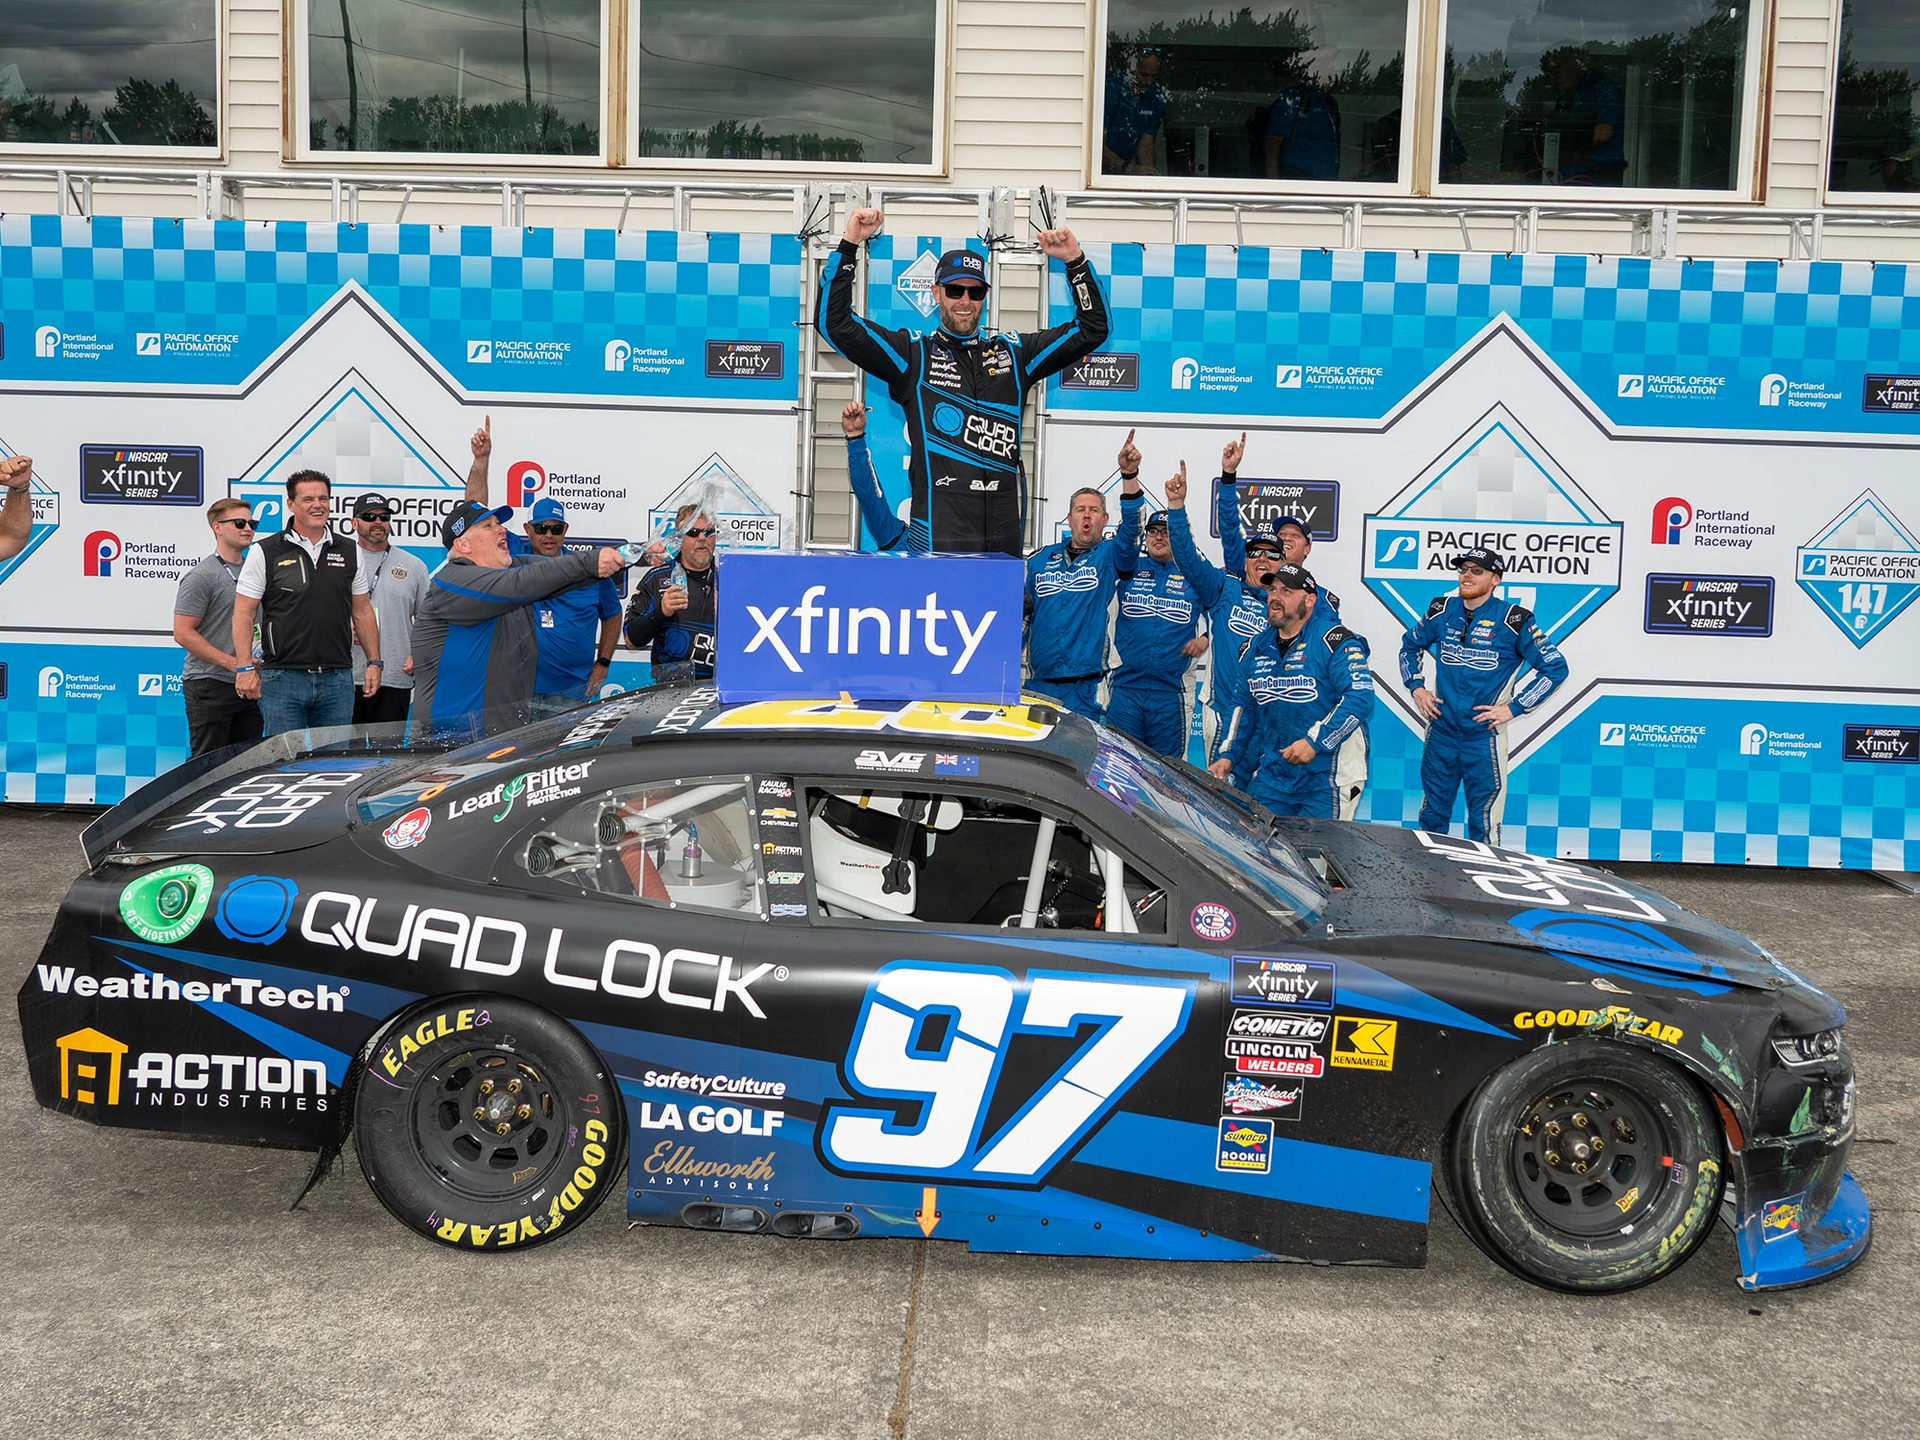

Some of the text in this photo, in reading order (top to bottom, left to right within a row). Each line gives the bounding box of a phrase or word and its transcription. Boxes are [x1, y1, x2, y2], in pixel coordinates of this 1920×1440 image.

[62, 333, 97, 342] Portland
[164, 334, 238, 343] PACIFIC OFFICE
[62, 342, 114, 351] International
[164, 342, 232, 352] AUTOMATION
[495, 342, 571, 352] PACIFIC OFFICE
[633, 347, 668, 356] Portland
[62, 350, 101, 360] Raceway
[496, 350, 563, 360] AUTOMATION
[1090, 356, 1117, 364] NASCAR
[633, 356, 685, 366] International
[719, 352, 770, 372] xfinity
[632, 364, 671, 375] Raceway
[1073, 363, 1126, 382] xfinity
[1200, 365, 1236, 374] Portland
[1306, 366, 1382, 376] PACIFIC OFFICE
[1088, 379, 1110, 387] SERIES
[1200, 374, 1253, 384] International
[1306, 374, 1374, 385] AUTOMATION
[1647, 376, 1726, 386] PACIFIC OFFICE
[1200, 382, 1239, 392] Raceway
[1647, 384, 1718, 395] AUTOMATION
[1788, 381, 1825, 390] Portland
[1788, 390, 1842, 400] International
[1876, 386, 1920, 405] xfinit
[1788, 399, 1827, 409] Raceway
[966, 414, 1016, 443] QUAD
[128, 452, 168, 463] NASCAR
[101, 464, 182, 492] xfinity
[549, 473, 600, 484] Portland
[125, 489, 158, 498] SERIES
[549, 486, 626, 498] International
[1262, 486, 1304, 497] NASCAR
[1696, 510, 1749, 522] Portland
[731, 520, 774, 531] OFFICE
[1695, 522, 1775, 536] International
[124, 542, 176, 554] Portland
[1427, 531, 1611, 554] PACIFIC OFFICE
[1694, 536, 1752, 550] Raceway
[1830, 555, 1920, 568] PACIFIC OFFIC
[124, 568, 180, 581] Raceway
[1830, 566, 1915, 579] AUTOMATION
[1696, 582, 1738, 594] NASCAR
[1838, 583, 1888, 614] 147
[1666, 593, 1752, 624] xfinity
[1690, 618, 1726, 629] SERIES
[743, 586, 998, 674] xfinity
[65, 674, 99, 682] Portland
[65, 682, 116, 691] International
[65, 690, 102, 700] Raceway
[1629, 724, 1706, 735] PACIFIC OFFICE
[1874, 729, 1900, 737] NASCAR
[1629, 734, 1698, 744] AUTOMATION
[1768, 731, 1805, 740] Portland
[1768, 740, 1822, 750] International
[1856, 737, 1910, 754] xfinity
[1768, 748, 1807, 758] Raceway
[1870, 752, 1893, 760] SERIES
[448, 759, 597, 820] Leaf Filter
[760, 780, 788, 788] KAULIG
[526, 785, 561, 800] GUTTER
[526, 786, 580, 808] PROTECTION
[760, 820, 799, 828] CHEVROLET
[840, 860, 880, 870] WeatherTech
[1196, 905, 1230, 920] NASCAR
[126, 910, 200, 942] GET BIOETHANOL
[1196, 924, 1231, 938] SALUTES
[300, 891, 528, 977] QUAD
[1270, 962, 1307, 974] NASCAR
[1247, 971, 1318, 1000] xfinity
[1267, 992, 1298, 1002] SERIES
[1232, 1016, 1324, 1038] COMETIC
[382, 1008, 476, 1078] EAGLE
[1230, 1042, 1308, 1060] LINCOLN
[1247, 1059, 1315, 1074] WELDERS
[1334, 1056, 1389, 1068] KENNAMETAL
[128, 1053, 327, 1095] ACTION
[823, 962, 1195, 1180] 97
[643, 1071, 786, 1096] SafetyCulture
[1224, 1082, 1299, 1100] Arrowhead
[135, 1092, 328, 1112] INDUSTRIES
[640, 1102, 785, 1136] LA GOLF
[1225, 1132, 1268, 1142] SUNOCO
[644, 1140, 776, 1180] Ellsworth
[1221, 1150, 1266, 1162] ROOKIE
[649, 1176, 769, 1191] ADVISORS
[1763, 1204, 1801, 1228] SUNOCO
